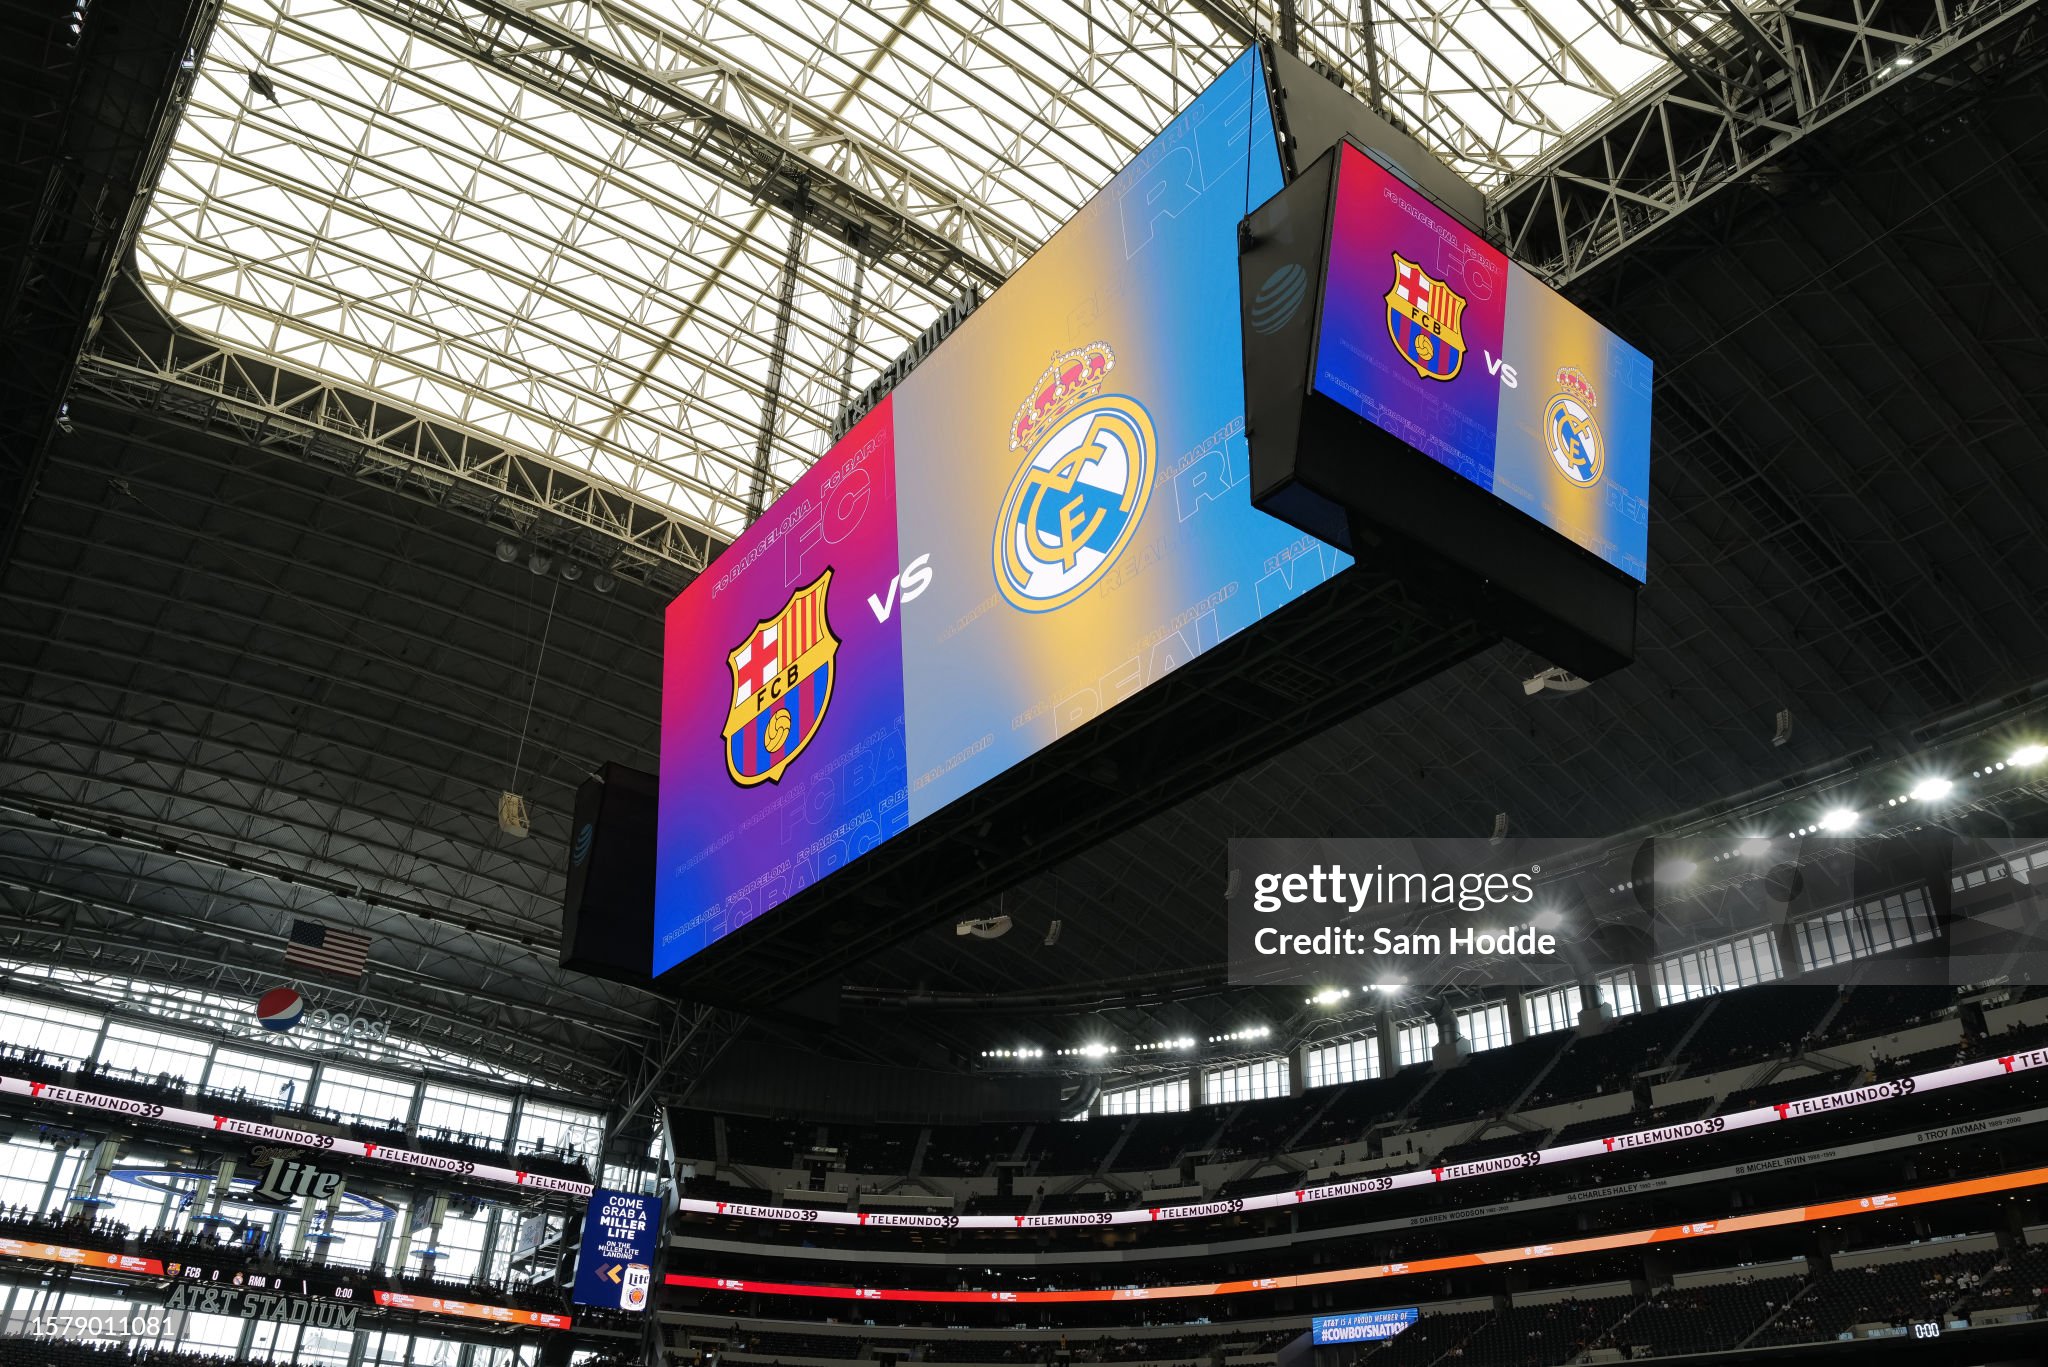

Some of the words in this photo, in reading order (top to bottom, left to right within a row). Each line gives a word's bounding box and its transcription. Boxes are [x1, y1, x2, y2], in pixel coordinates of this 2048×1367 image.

[1399, 198, 1458, 247] BARCELONA
[1437, 235, 1492, 300] FC
[882, 282, 979, 398] STADIUM
[1483, 349, 1518, 389] VS
[785, 468, 871, 588] FC
[712, 575, 730, 600] FC
[729, 498, 812, 583] BARCELONA
[866, 552, 935, 625] VS
[755, 663, 801, 714] FCB
[811, 808, 873, 857] BARCELONA
[737, 858, 792, 902] BARCELONA
[305, 1008, 392, 1043] pepsi
[47, 1087, 164, 1118] TELEMUNDO39
[1792, 1078, 1916, 1115] TELEMUNDO39
[229, 1120, 335, 1149] TELEMUNDO39
[1618, 1117, 1725, 1149] TELEMUNDO39
[1918, 1133, 1924, 1142] 8
[1924, 1128, 1949, 1141] TROY
[1950, 1121, 1987, 1136] AIKMAN
[378, 1148, 476, 1175] TELEMUNDO39
[1446, 1151, 1541, 1178] TELEMUNDO39
[1746, 1159, 1783, 1173] MICHAEL
[1783, 1155, 1806, 1167] IRVIN
[256, 1157, 341, 1201] Lite
[1307, 1177, 1393, 1200] TELEMUNDO39
[609, 1196, 644, 1210] COME
[1567, 1193, 1577, 1202] 94
[1577, 1187, 1613, 1201] CHARLES
[1613, 1184, 1638, 1195] HALEY
[602, 1206, 636, 1219] GRAB
[638, 1211, 647, 1221] A
[729, 1204, 818, 1221] TELEMUNDO39
[1027, 1213, 1113, 1227] TELEMUNDO39
[1161, 1199, 1244, 1219] TELEMUNDO39
[1419, 1213, 1448, 1225] DARREN
[1449, 1208, 1485, 1221] WOODSON
[600, 1215, 646, 1231] MILLER
[871, 1214, 960, 1229] TELEMUNDO39
[606, 1240, 617, 1248] ON
[617, 1241, 631, 1249] THE
[607, 1228, 636, 1240] LITE
[598, 1244, 623, 1254] MILLER
[624, 1248, 640, 1256] LITE
[602, 1250, 633, 1260] LANDING
[184, 1266, 201, 1279] FCB
[211, 1270, 219, 1281] 0
[248, 1275, 266, 1288] RMA
[274, 1278, 281, 1289] 0
[335, 1287, 353, 1299] 0:00
[165, 1283, 239, 1316] AT&T
[240, 1292, 360, 1332] STADIUM
[1322, 1318, 1339, 1328] AT&T
[1340, 1318, 1346, 1326] IS
[1347, 1317, 1352, 1325] A
[1353, 1316, 1373, 1325] PROUD
[1374, 1313, 1398, 1323] MEMBER
[1400, 1312, 1408, 1321] OF
[1915, 1322, 1940, 1339] 0:00
